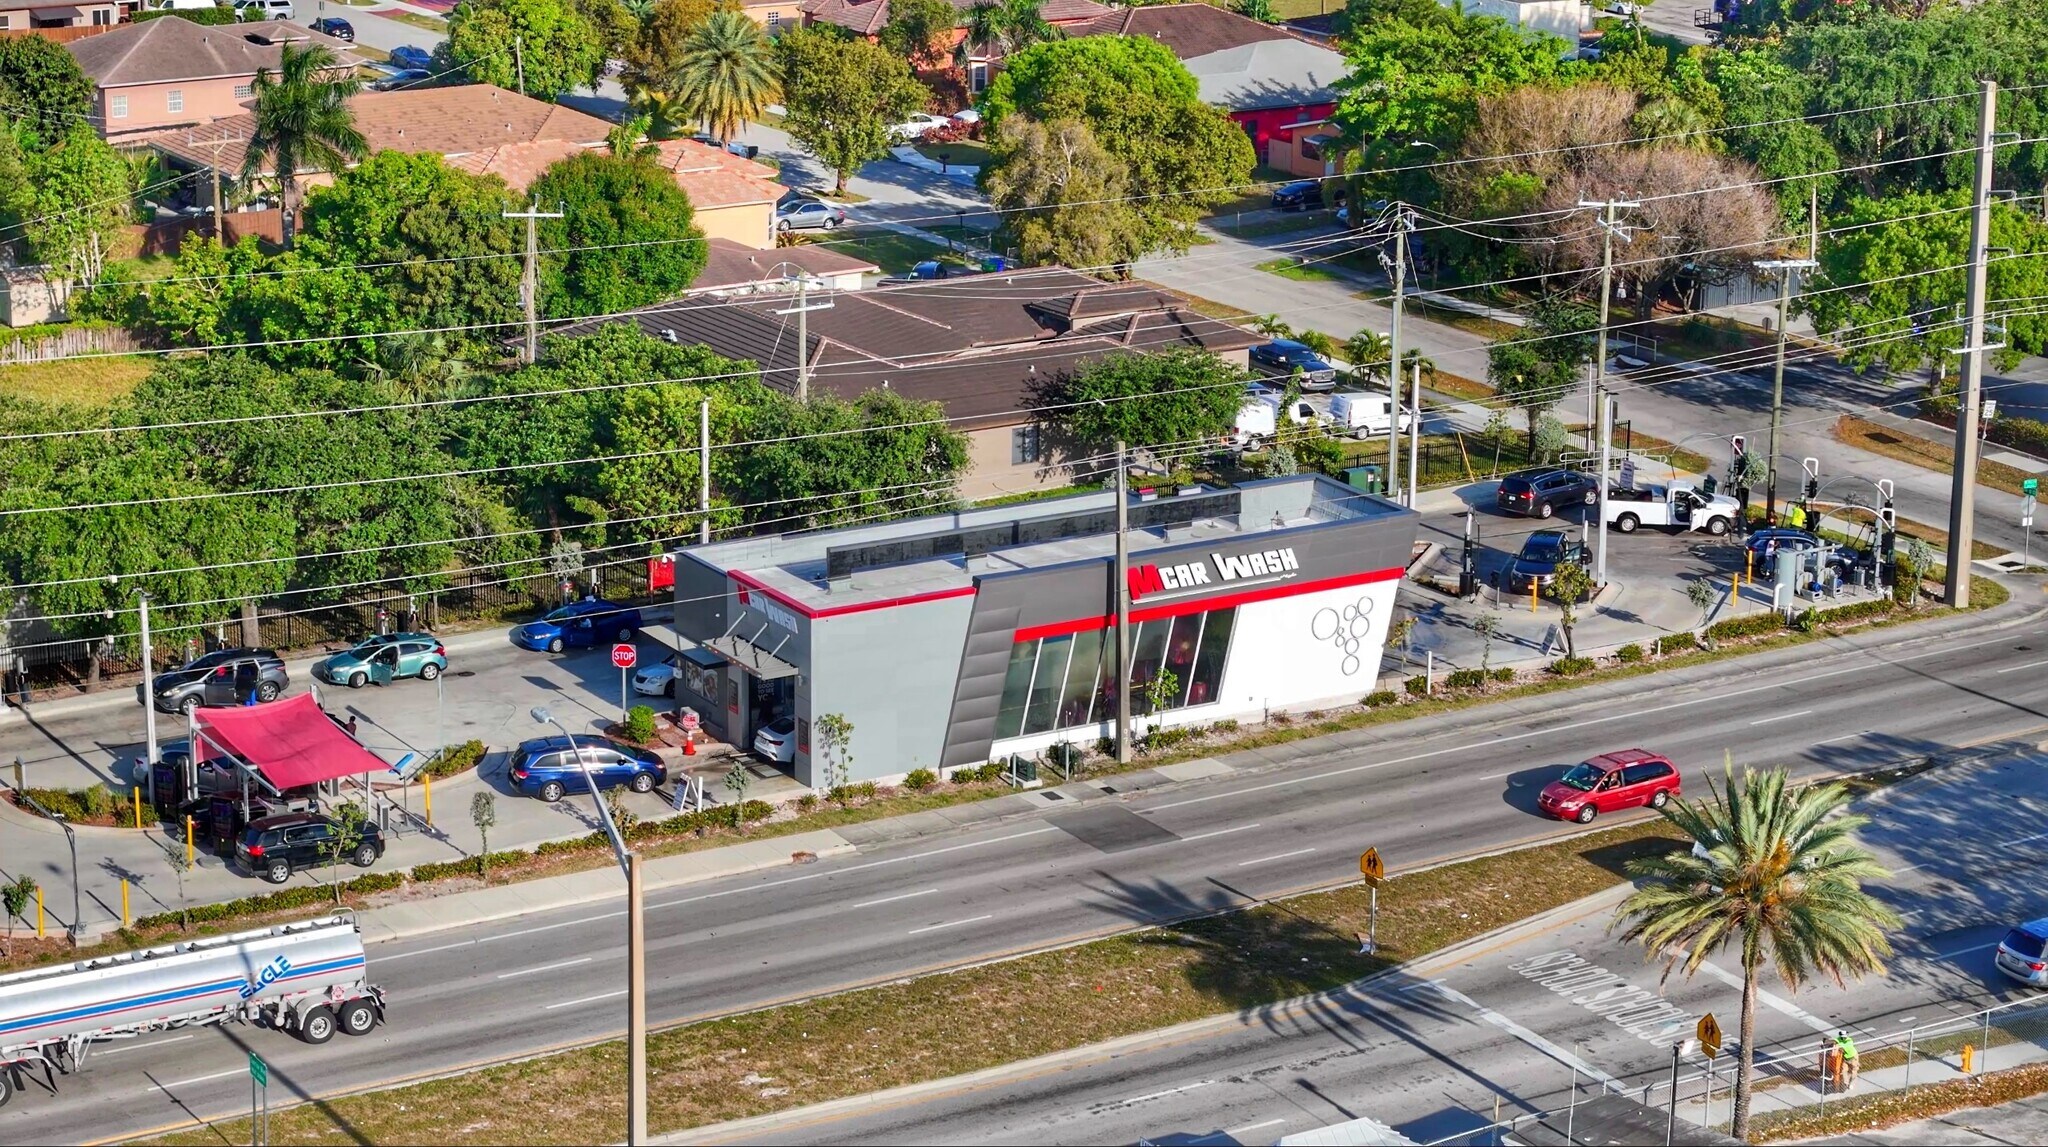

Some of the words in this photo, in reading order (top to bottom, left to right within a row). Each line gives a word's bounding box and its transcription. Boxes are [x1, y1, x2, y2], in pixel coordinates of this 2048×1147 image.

[1210, 548, 1299, 581] WASH
[614, 651, 634, 661] STOP
[1507, 948, 1625, 998] SCHOOL
[1573, 985, 1692, 1034] SCHOOL
